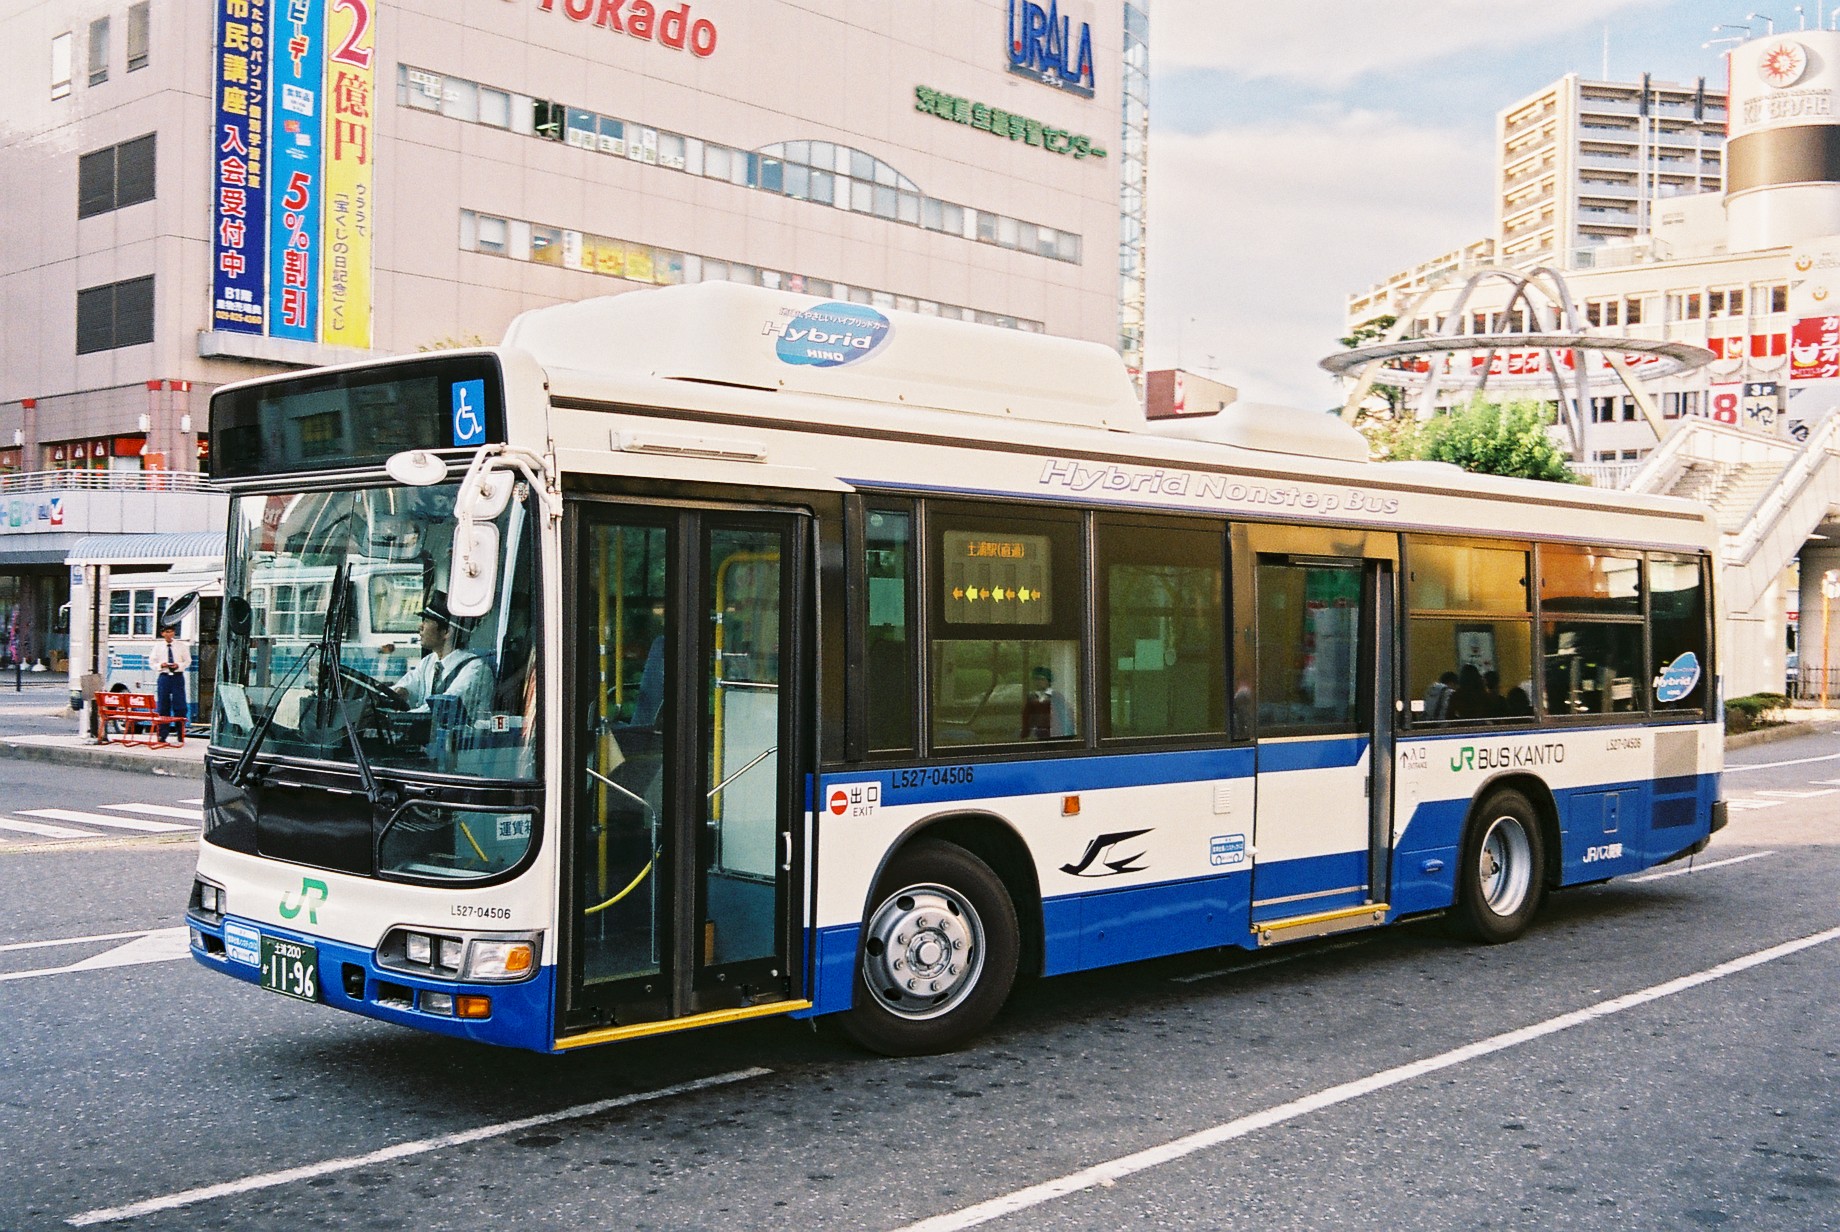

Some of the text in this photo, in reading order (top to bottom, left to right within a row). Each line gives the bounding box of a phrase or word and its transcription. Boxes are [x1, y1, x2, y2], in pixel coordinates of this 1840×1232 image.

[537, 0, 717, 57] okado
[1009, 0, 1094, 88] URALA
[330, 0, 374, 165] 2億円
[224, 287, 254, 302] B1
[762, 320, 872, 350] Hybrid
[1821, 316, 1839, 378] カラオケ
[807, 349, 845, 361] HINO
[1039, 459, 1399, 514] Hybrid Nonstep Bus
[1450, 743, 1565, 772] JR BUS KANTO
[892, 766, 975, 789] L527-04506
[850, 786, 878, 804] 出口
[852, 805, 874, 817] EXIT
[1582, 842, 1623, 863] JRバス
[279, 877, 329, 925] JR
[450, 904, 512, 920] L527-04506
